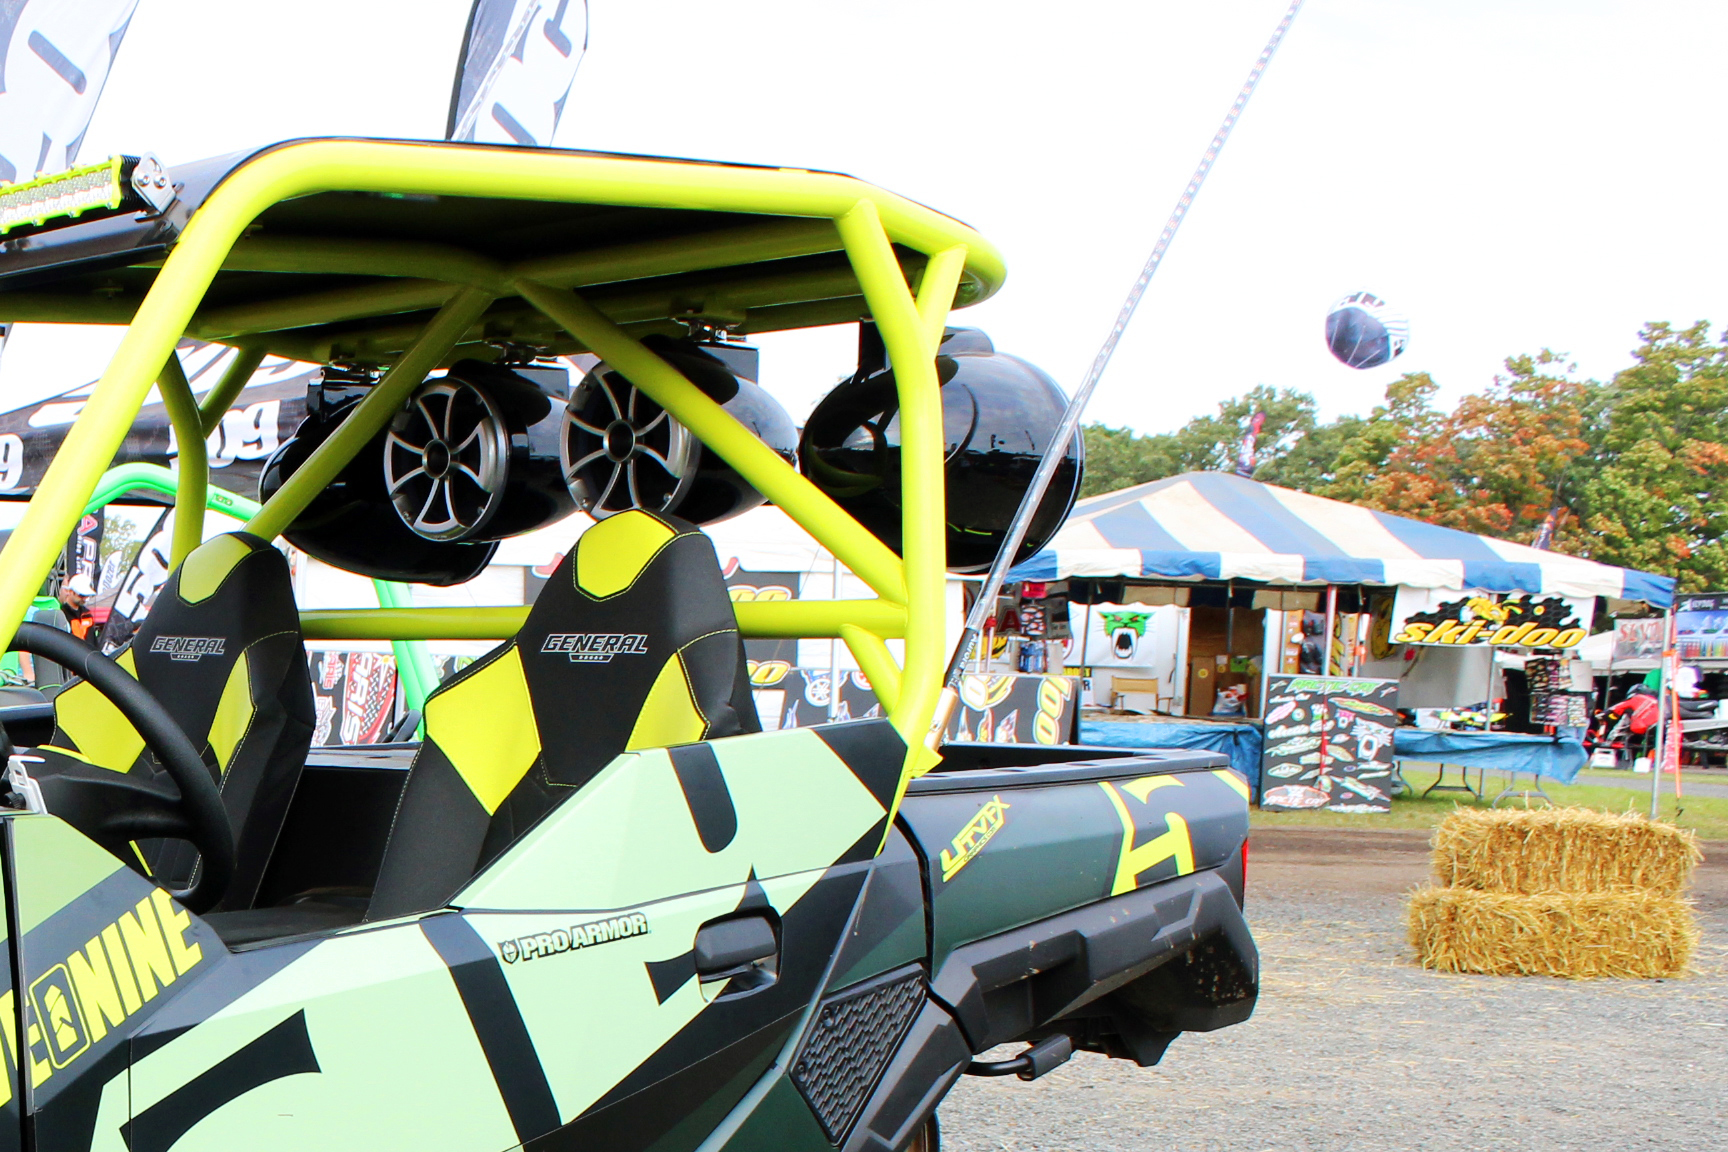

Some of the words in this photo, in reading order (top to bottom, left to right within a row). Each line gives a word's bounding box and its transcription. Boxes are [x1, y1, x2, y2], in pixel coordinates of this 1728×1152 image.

[150, 636, 226, 655] GENERAL
[540, 634, 649, 654] GENERAL
[1395, 619, 1587, 648] ski-doo
[517, 928, 571, 962] PRO
[570, 911, 648, 951] ARMOR
[66, 886, 204, 1043] NINE
